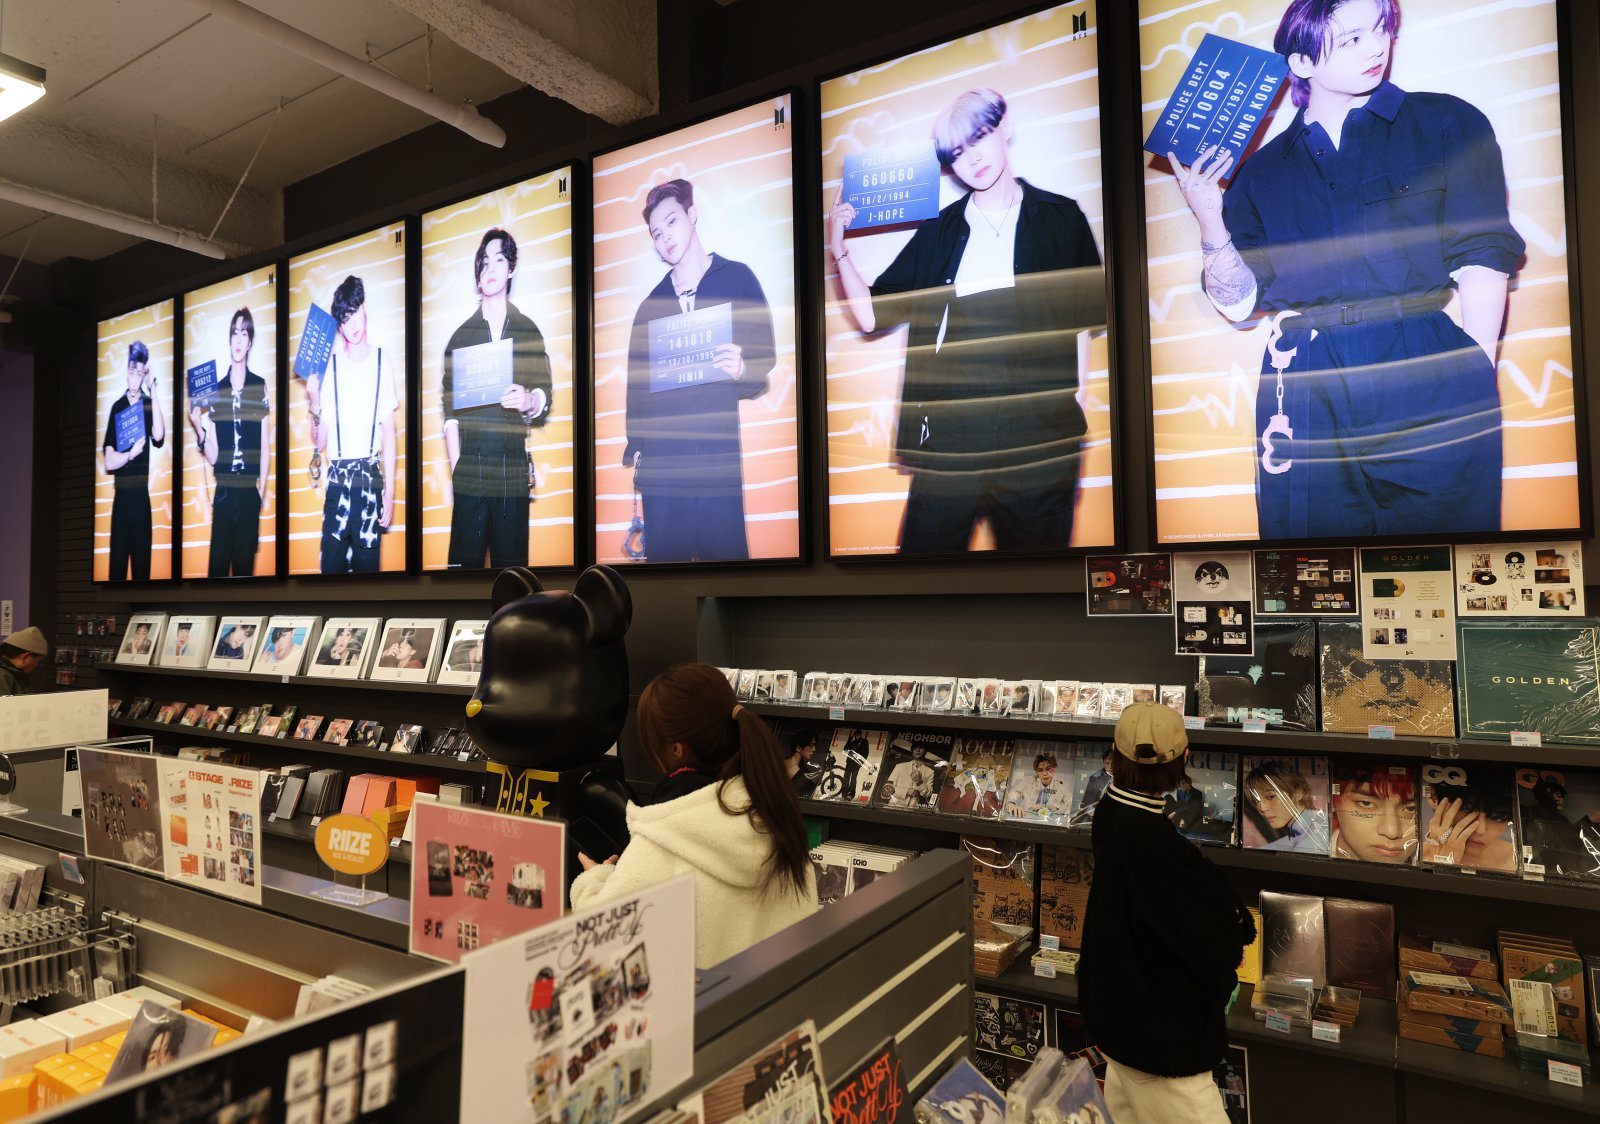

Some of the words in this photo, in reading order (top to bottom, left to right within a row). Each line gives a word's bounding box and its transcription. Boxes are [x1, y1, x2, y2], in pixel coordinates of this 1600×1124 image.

[1166, 90, 1193, 127] POLICE
[1188, 61, 1209, 87] DEPT
[1186, 69, 1231, 131] 110604
[1212, 81, 1248, 134] 1/9/1997
[1230, 113, 1256, 148] JUNG
[1249, 75, 1279, 110] KOOK
[863, 167, 914, 188] 660660
[862, 190, 909, 205] 18/2/1994
[868, 208, 905, 223] J-HOPE
[669, 330, 712, 351] 141018
[322, 342, 332, 363] SUGA
[668, 350, 714, 367] 13/10/1995
[678, 369, 704, 384] JIMIN
[1492, 676, 1569, 685] GOLDEN
[1227, 707, 1283, 725] MUSE
[898, 732, 952, 745] NEIGHBOR
[196, 772, 223, 785] STAGE
[231, 778, 253, 790] RIIZE
[1422, 765, 1468, 787] GQ
[328, 828, 373, 857] RIIZE
[853, 859, 867, 867] ECHO
[576, 912, 605, 936] NOT
[605, 899, 640, 923] JUST
[764, 1060, 799, 1111] JUST
[829, 1083, 857, 1122] NOT
[860, 1052, 892, 1098] JUST
